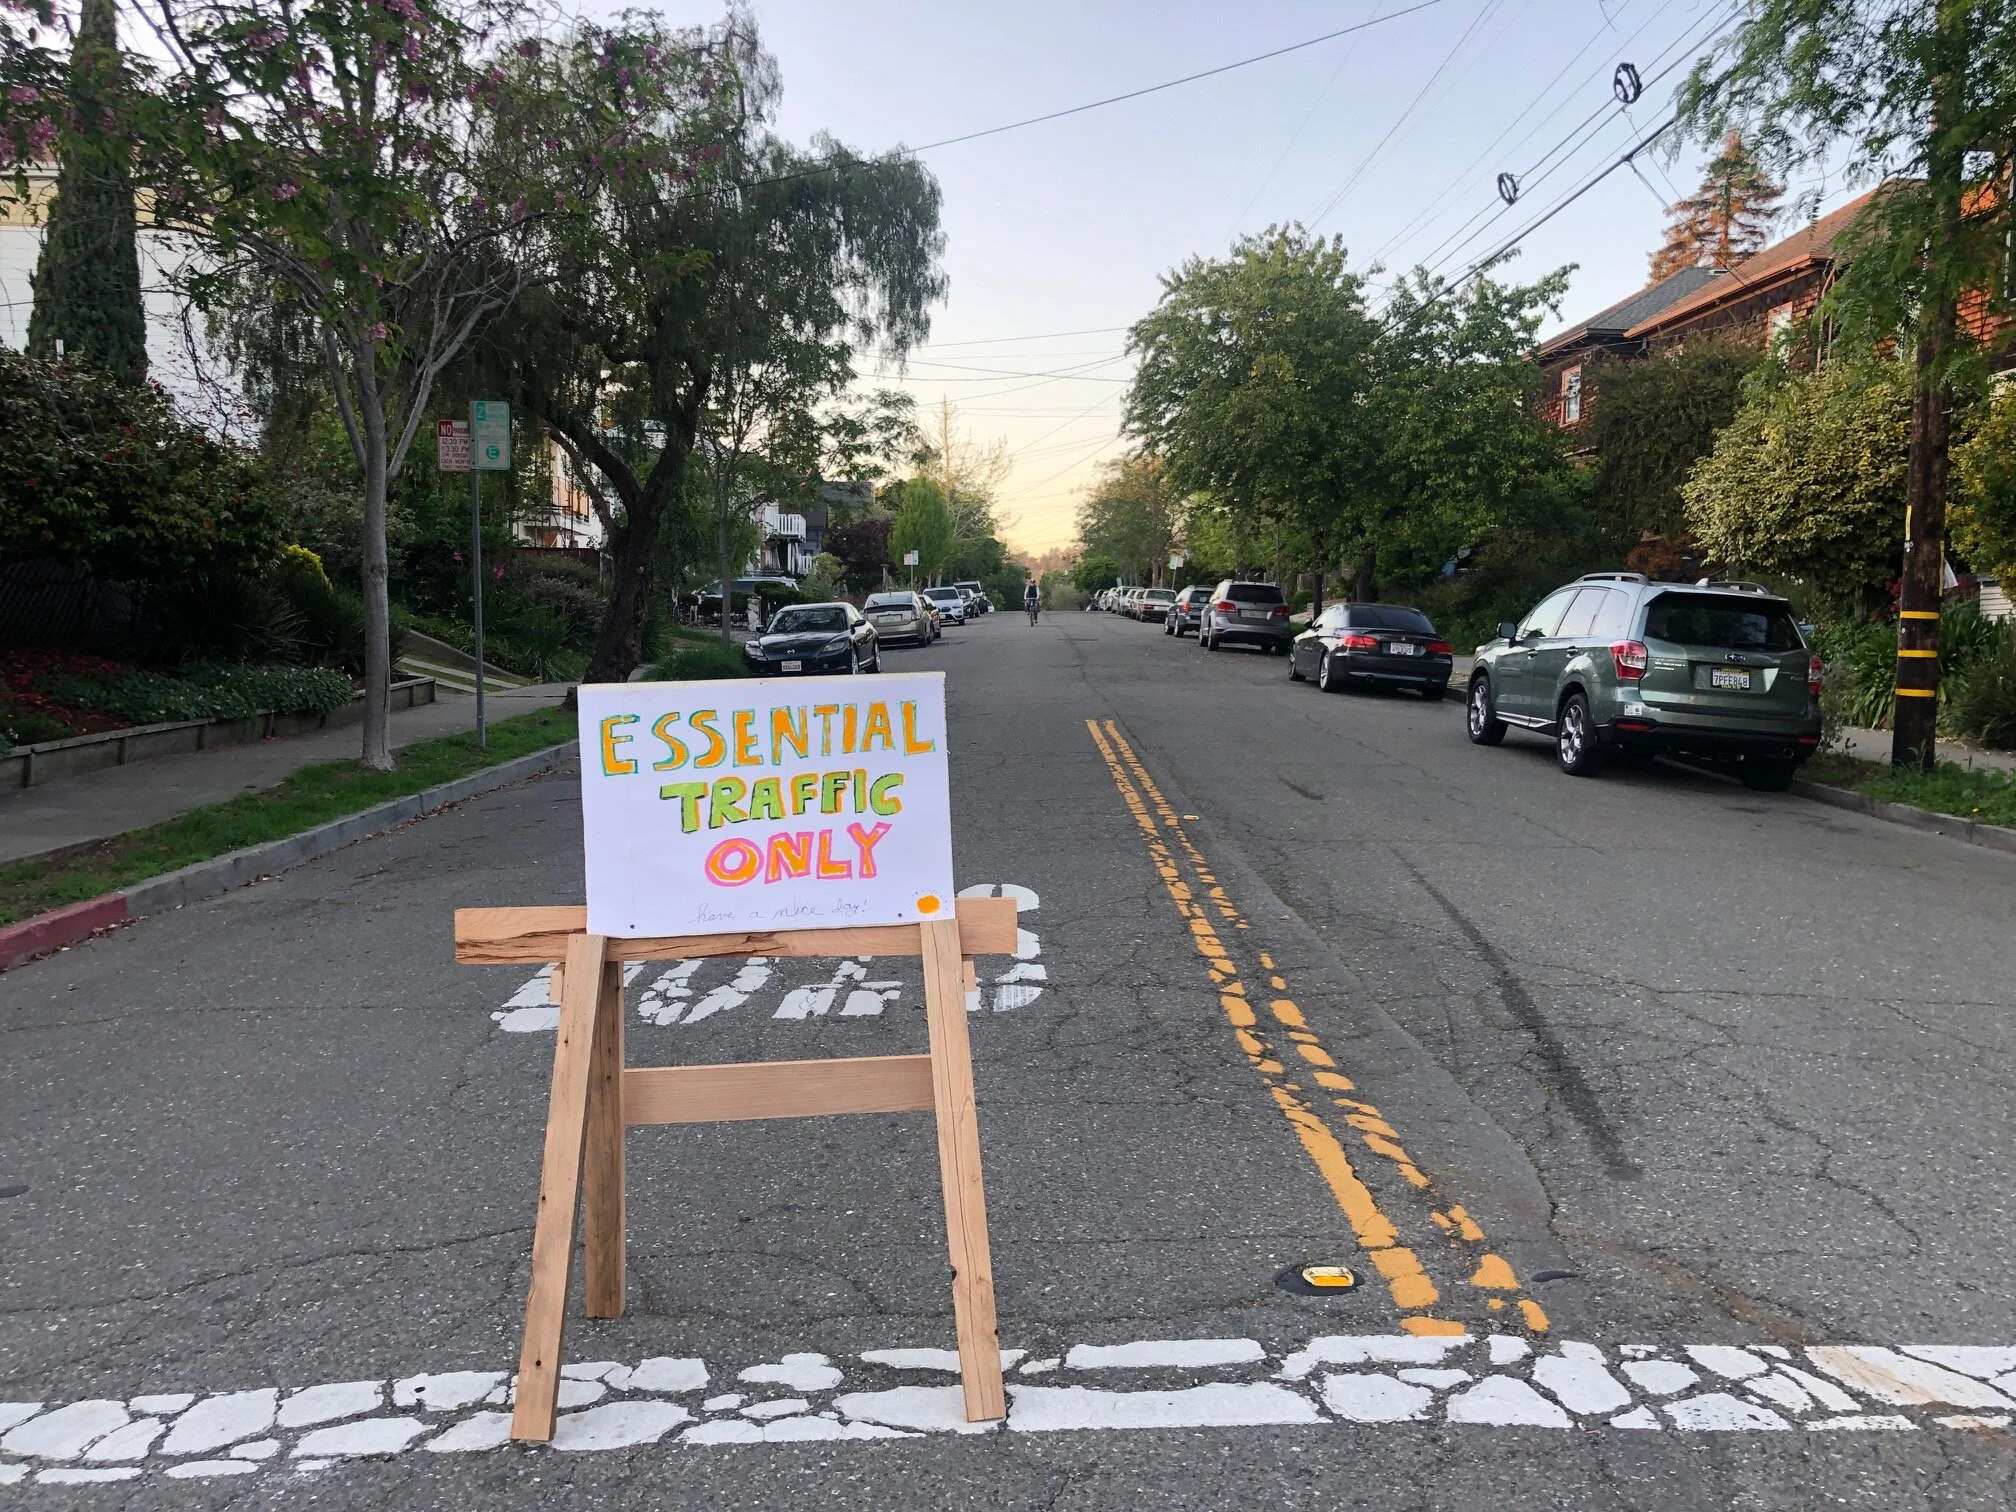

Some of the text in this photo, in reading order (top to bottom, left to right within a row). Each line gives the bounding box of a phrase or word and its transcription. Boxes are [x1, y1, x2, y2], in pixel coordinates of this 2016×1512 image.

[441, 424, 452, 436] NO
[600, 700, 935, 777] ESSENTIAL
[659, 768, 904, 833] TRAFFIC
[704, 822, 892, 887] ONLY
[688, 899, 868, 924] have a nice day!
